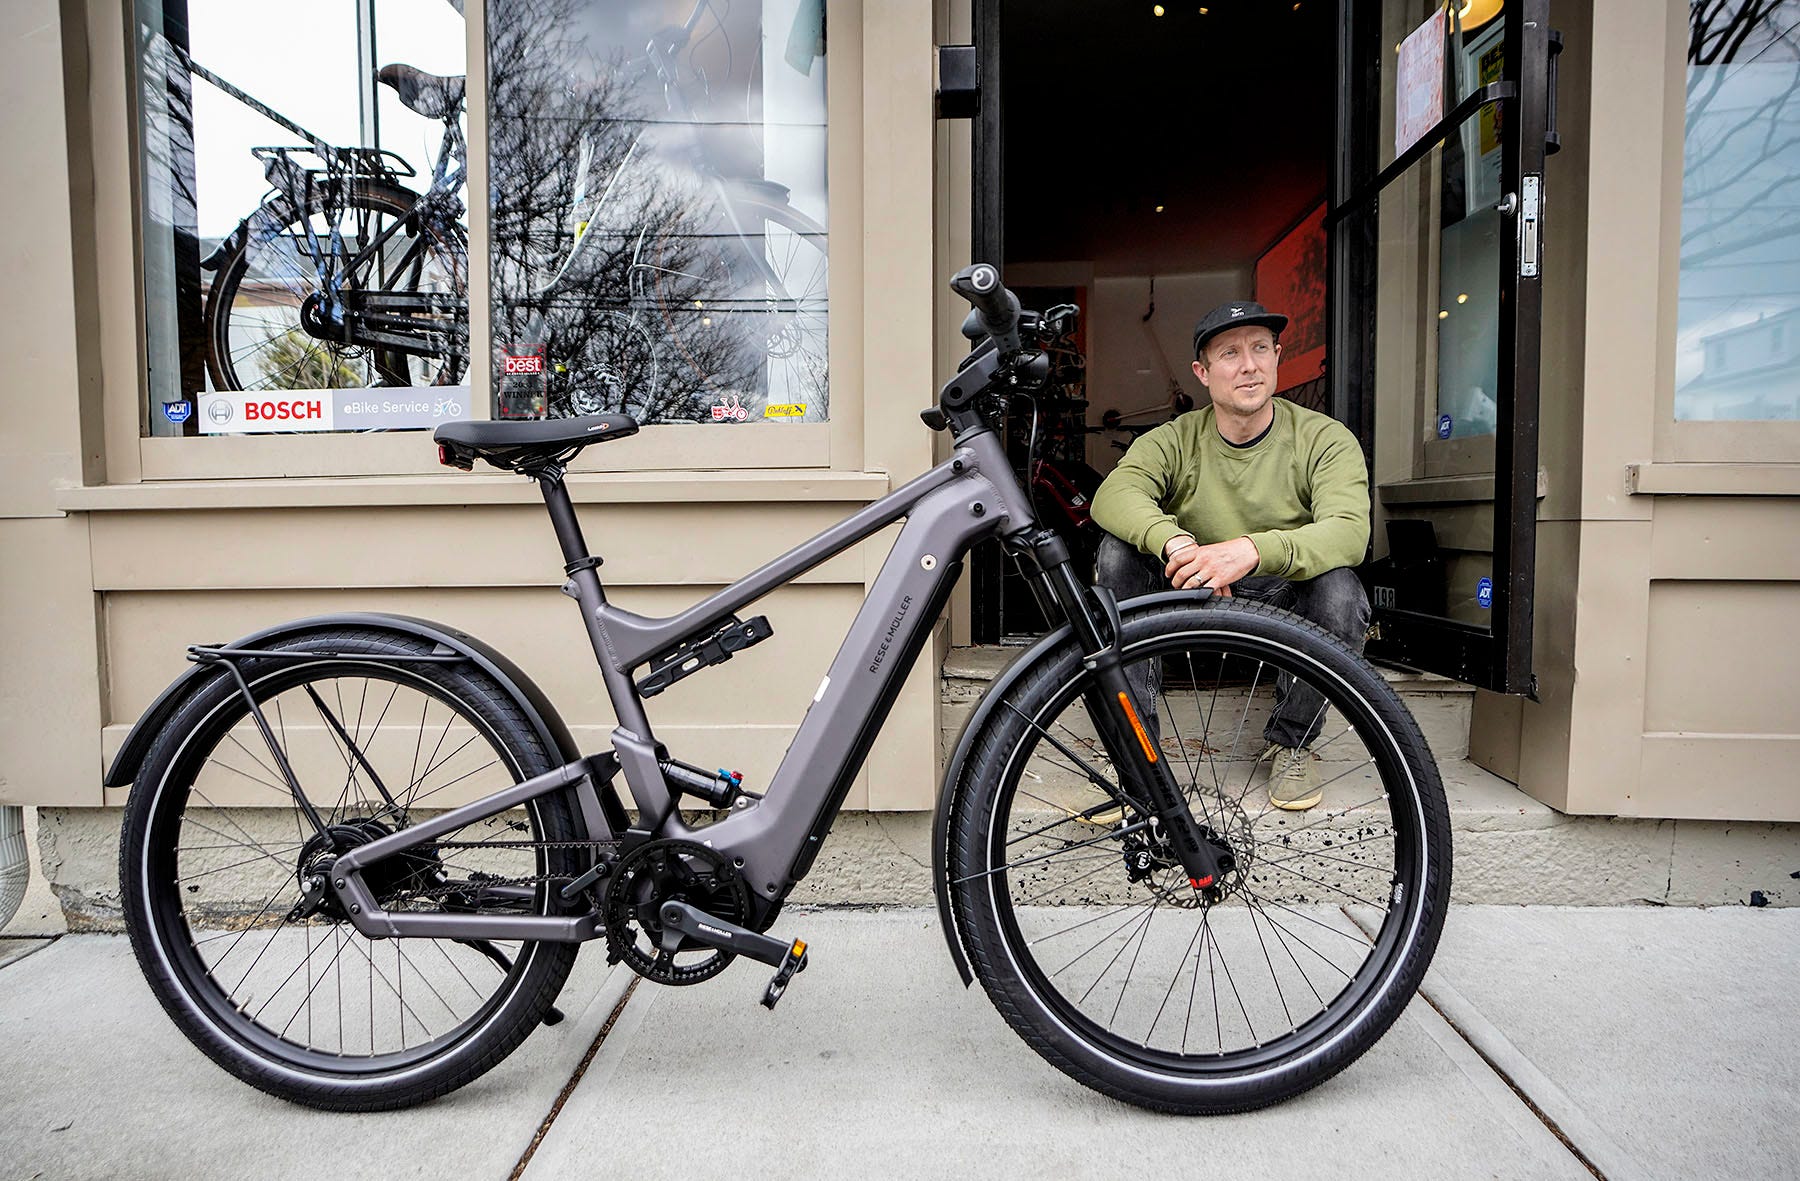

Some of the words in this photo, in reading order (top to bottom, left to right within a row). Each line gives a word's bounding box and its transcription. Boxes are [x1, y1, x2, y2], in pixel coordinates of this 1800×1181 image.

[505, 357, 541, 372] best
[167, 403, 187, 414] ADT
[245, 401, 322, 420] BOSCH
[343, 401, 379, 414] eBike
[382, 401, 430, 413] Service
[1440, 420, 1450, 430] ADT
[1375, 587, 1394, 609] 198
[1479, 587, 1492, 599] ADT
[869, 642, 889, 674] RIESE
[887, 595, 913, 638] MÜLLER
